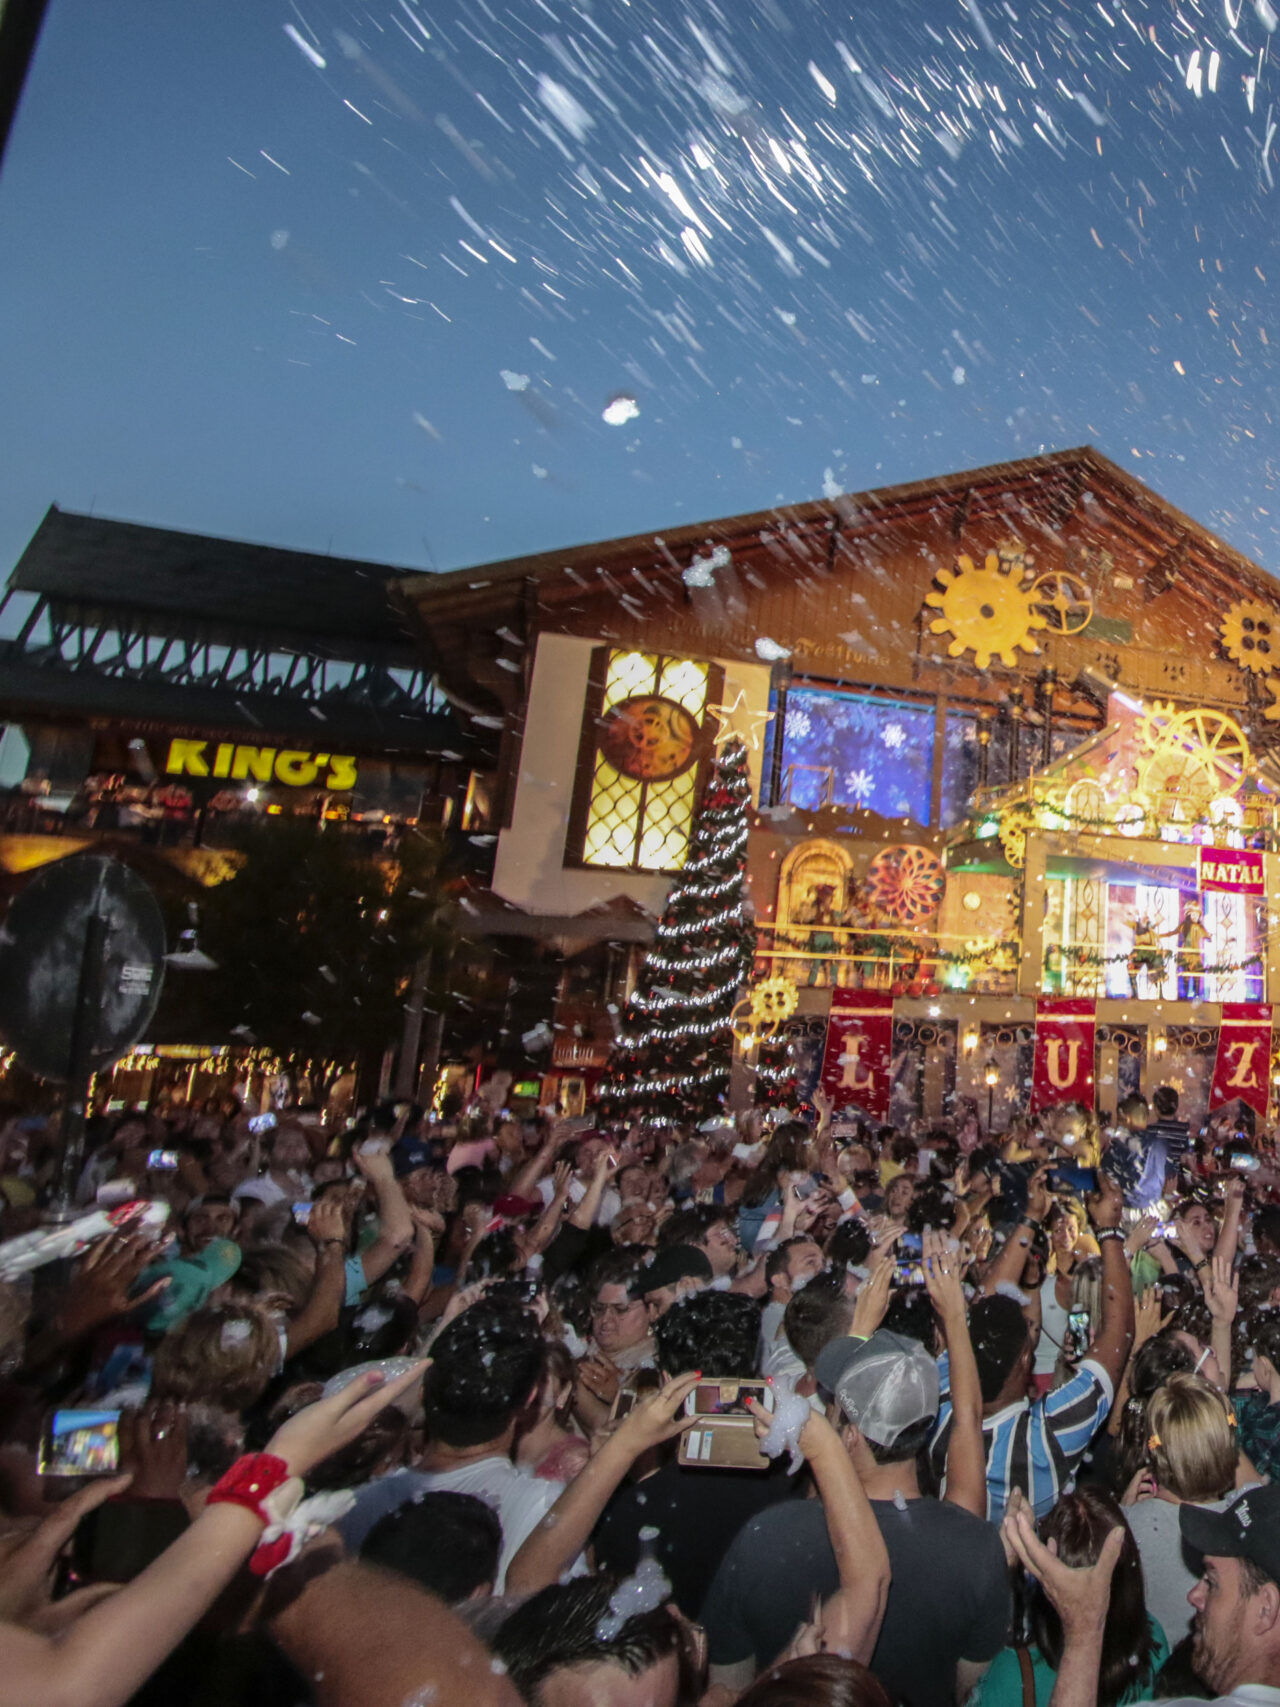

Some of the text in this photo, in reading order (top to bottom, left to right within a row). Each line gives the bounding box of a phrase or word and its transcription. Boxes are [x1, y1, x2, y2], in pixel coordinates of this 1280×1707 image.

[165, 738, 358, 790] KING'S
[1200, 862, 1264, 885] NATAL
[836, 1032, 1260, 1091] L U Z
